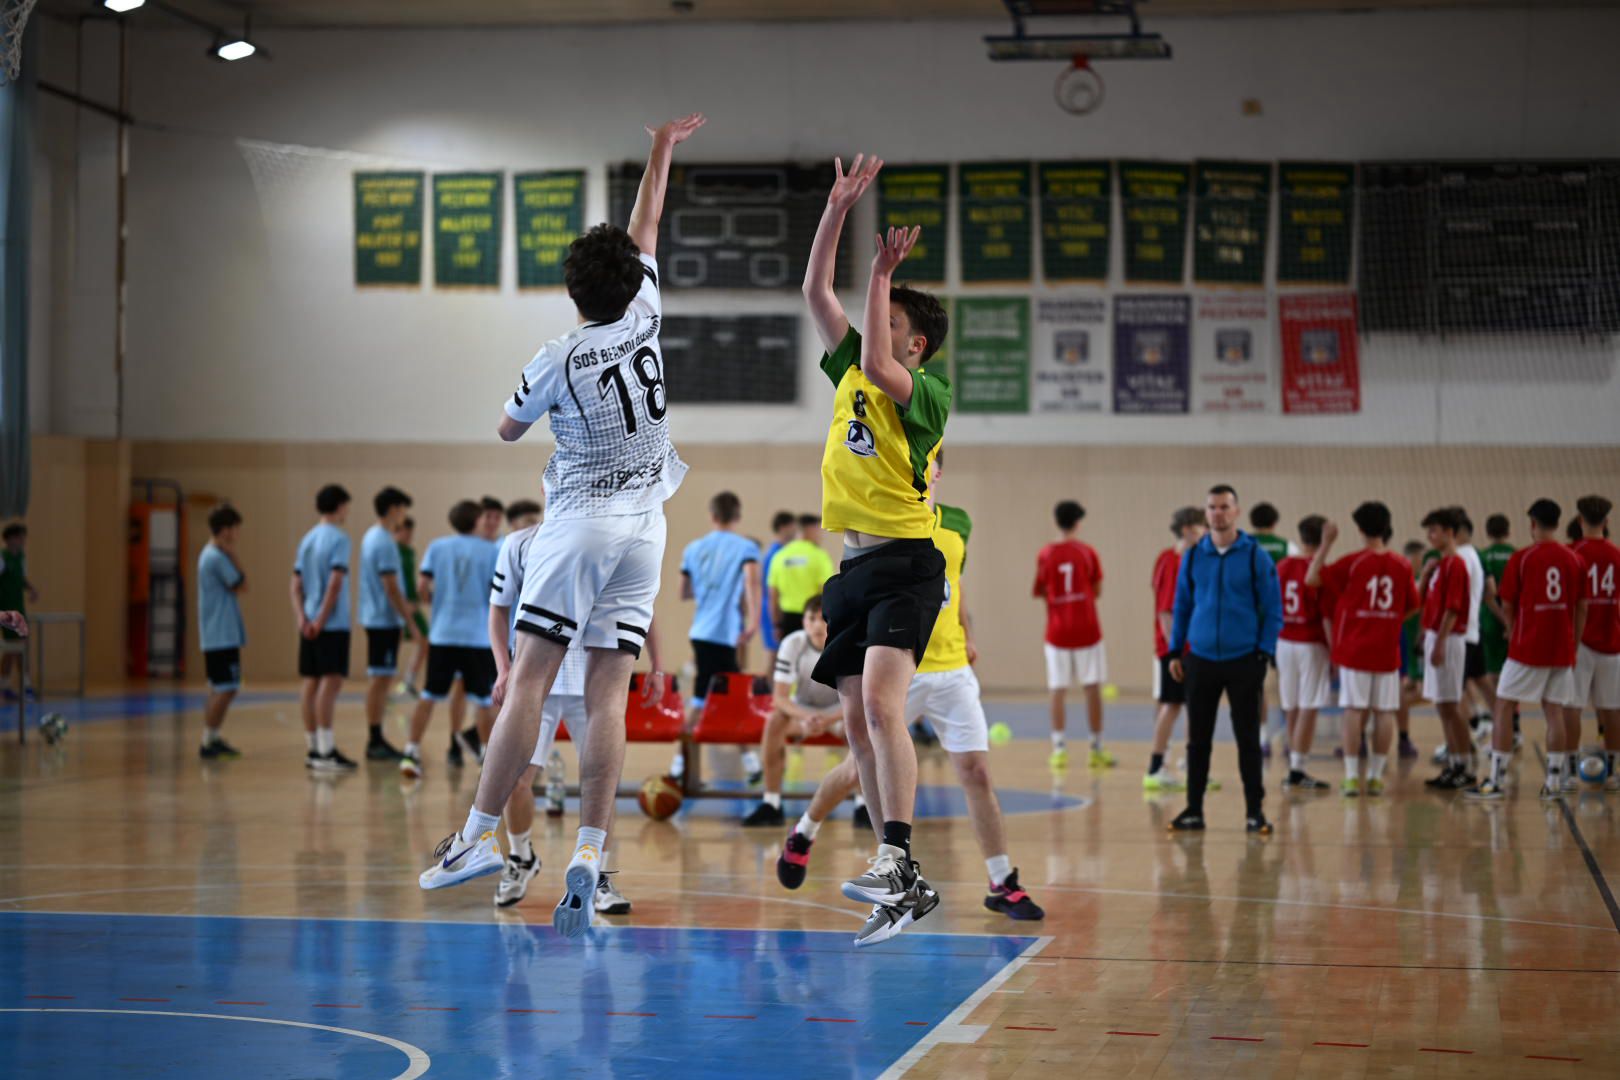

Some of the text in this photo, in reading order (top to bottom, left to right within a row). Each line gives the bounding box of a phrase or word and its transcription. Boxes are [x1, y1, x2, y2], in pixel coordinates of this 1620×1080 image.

[573, 347, 598, 370] SOŠ
[597, 345, 667, 441] 18
[853, 390, 866, 417] 8
[1057, 562, 1074, 593] 1
[1365, 575, 1394, 610] 13
[1545, 566, 1562, 602] 8
[1587, 562, 1616, 597] 14
[1284, 579, 1299, 615] 5
